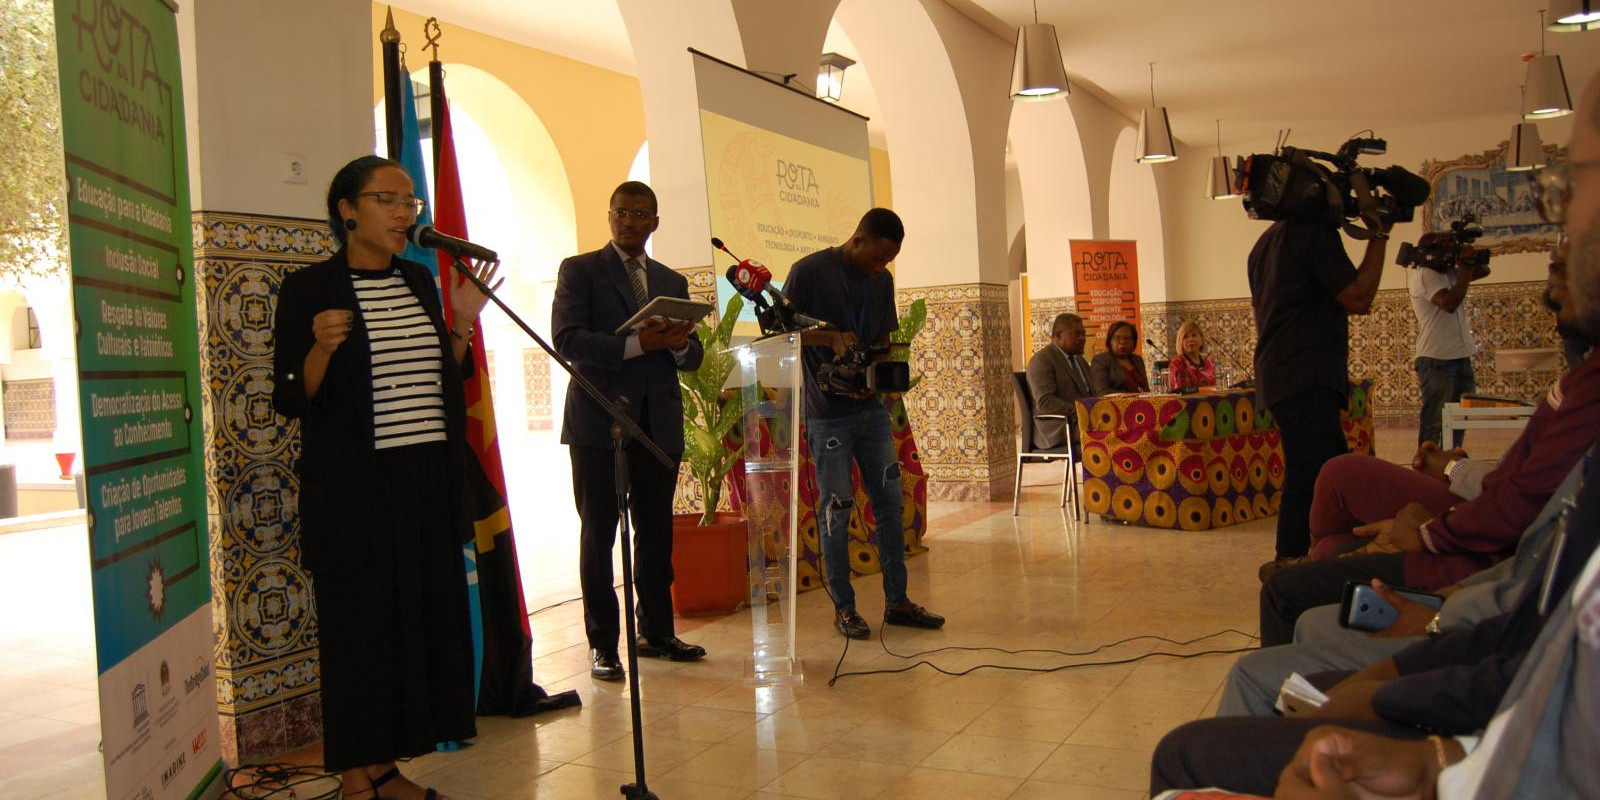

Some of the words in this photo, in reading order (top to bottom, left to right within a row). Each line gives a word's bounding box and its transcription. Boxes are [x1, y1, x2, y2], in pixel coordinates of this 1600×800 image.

[79, 68, 165, 146] CIDADANIA
[776, 159, 820, 195] ROTA
[77, 177, 116, 219] Educação
[117, 196, 135, 220] para
[136, 204, 140, 222] a
[141, 203, 172, 234] Cidadania
[779, 190, 820, 209] CIDADANIA
[757, 223, 784, 236] EDUCAÇÃO
[789, 228, 813, 240] DESPORTO
[766, 240, 795, 252] TECNOLOGIA
[105, 244, 137, 274] Inclusão
[138, 254, 160, 280] Social
[1080, 251, 1128, 271] ROTA
[1083, 273, 1128, 281] CIDADANIA
[1090, 288, 1122, 297] EDUCAÇÃO
[101, 299, 134, 330] Resgate
[135, 307, 142, 327] de
[142, 307, 168, 329] Valores
[97, 331, 132, 356] Culturais
[133, 338, 139, 356] e
[140, 334, 174, 357] Patrióticos
[91, 389, 151, 420] Democratização
[152, 390, 160, 411] do
[162, 390, 183, 411] Acesso
[114, 428, 124, 447] ao
[124, 418, 173, 445] Conhecimento
[101, 478, 131, 512] Criação
[131, 477, 141, 499] de
[143, 467, 187, 499] Oportunidades
[115, 514, 131, 543] para
[132, 506, 155, 531] Jovens
[155, 496, 182, 523] Talentos
[160, 751, 186, 786] IMAGINE
